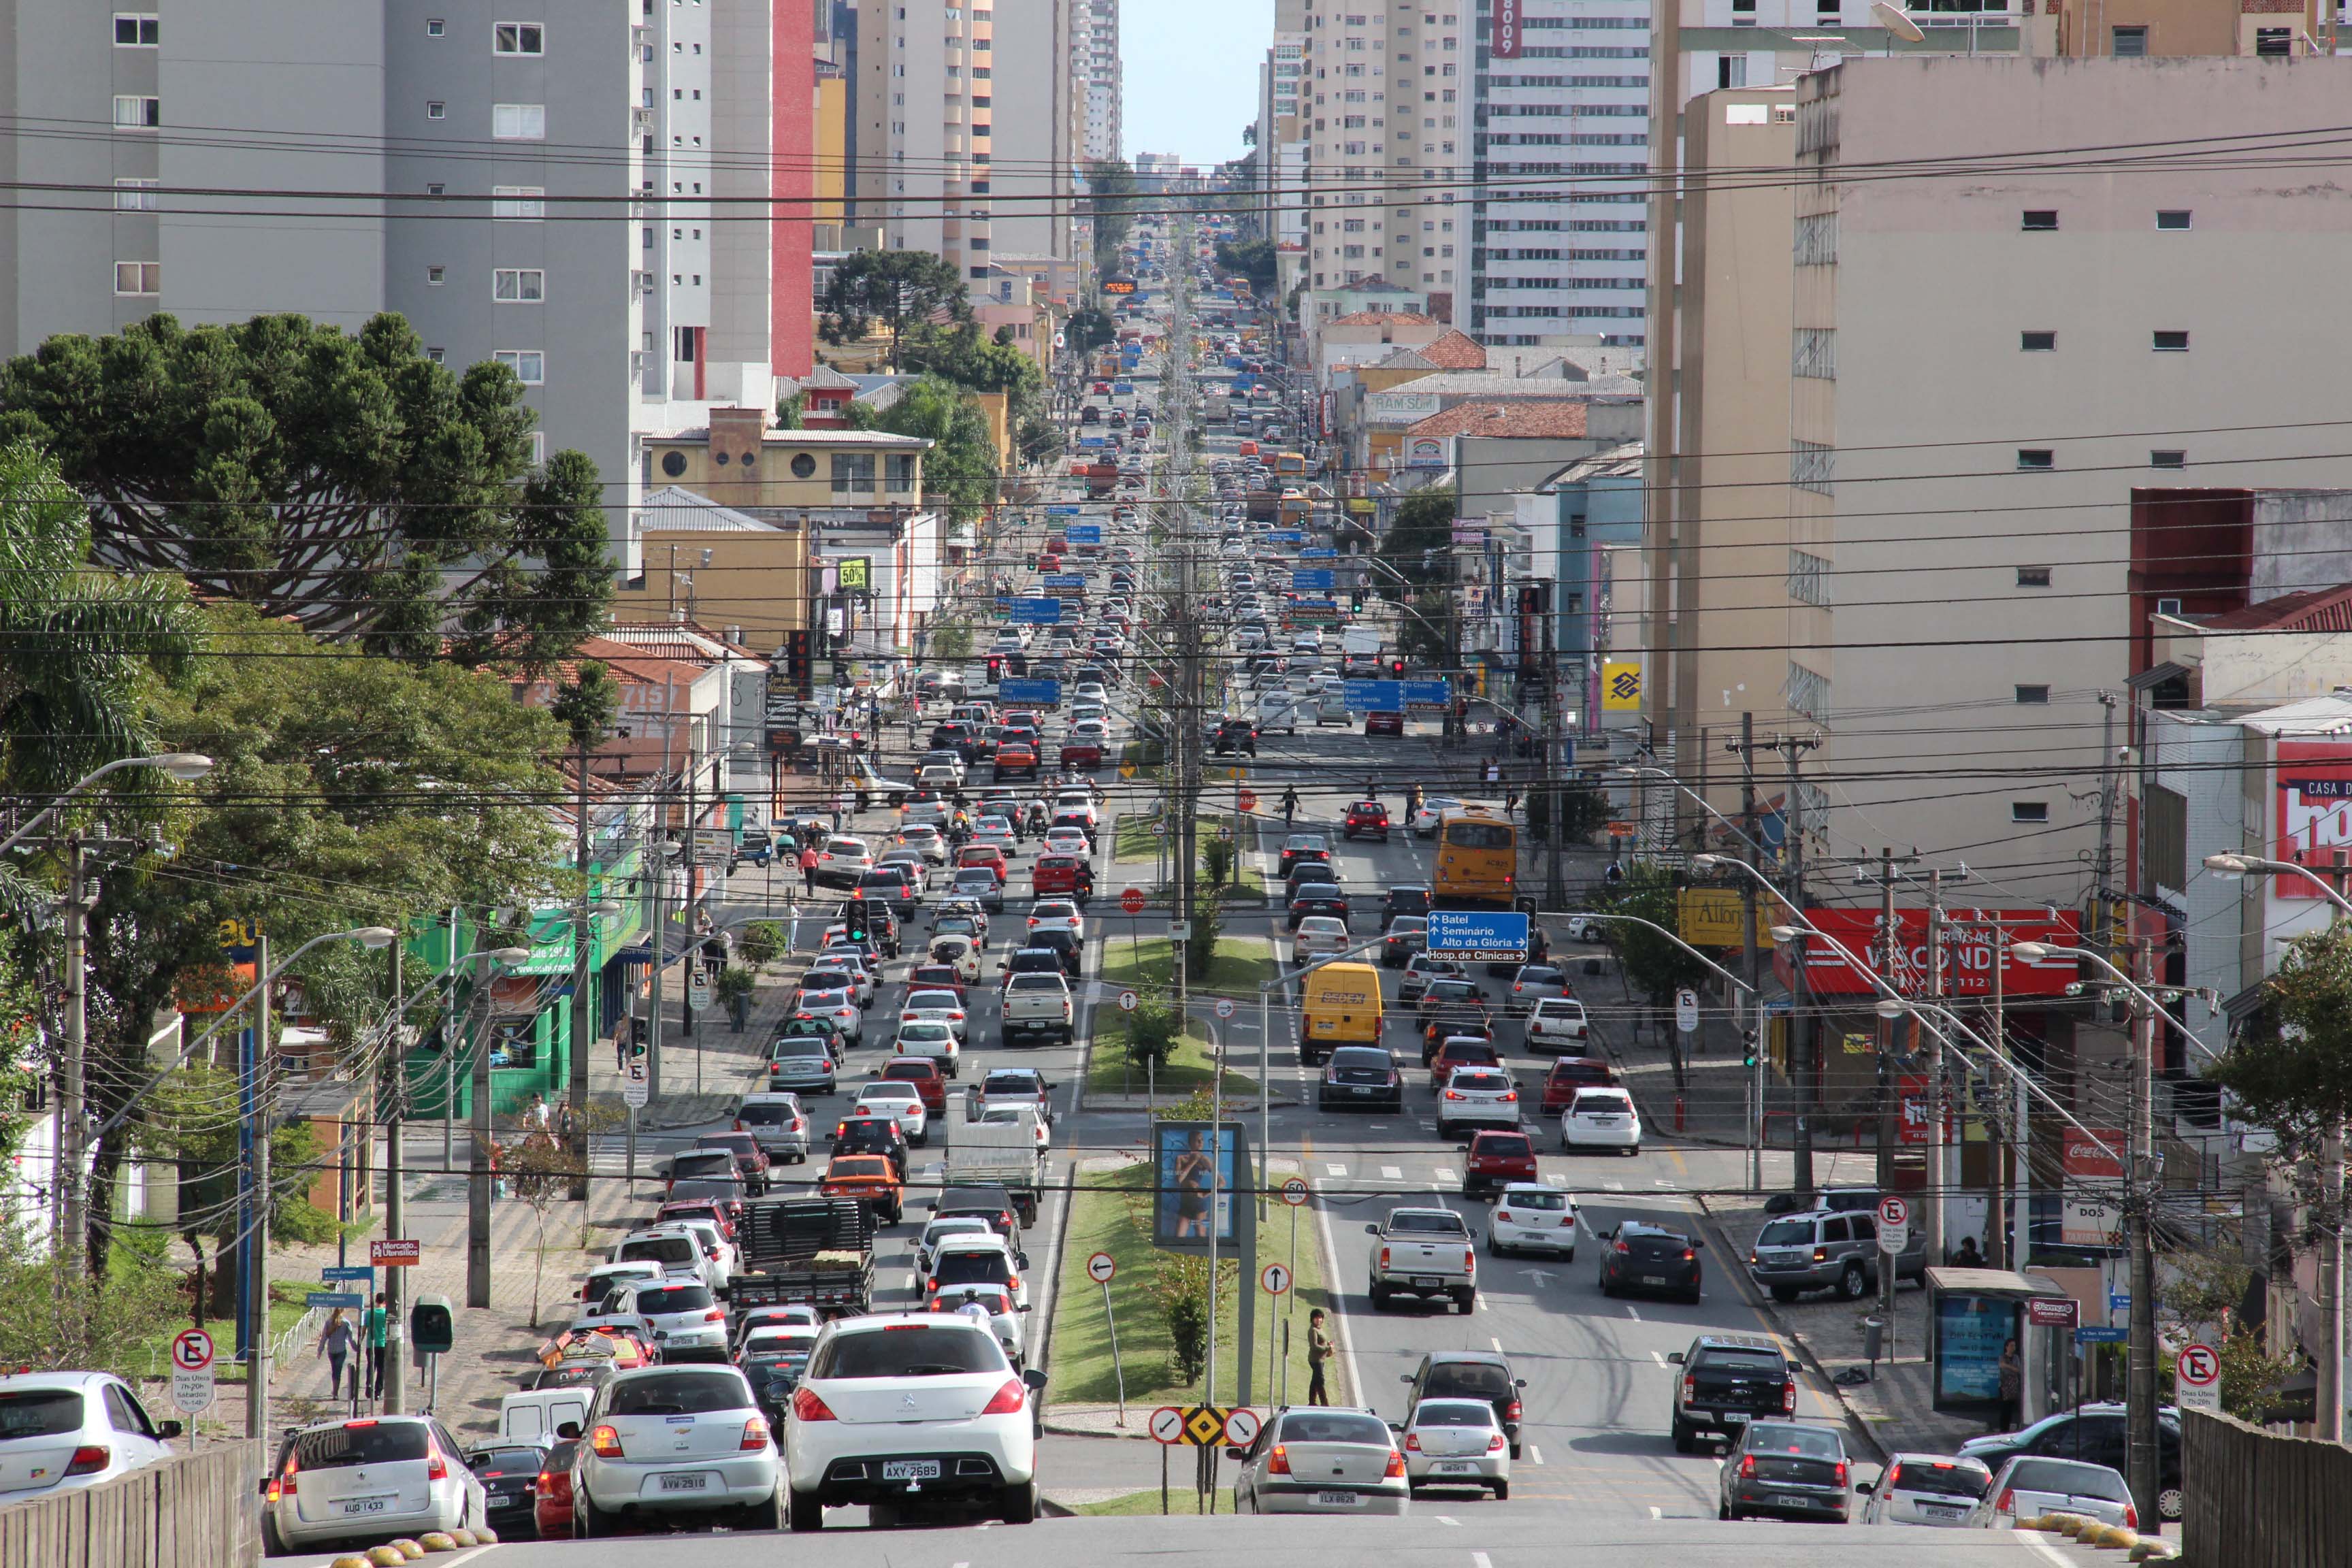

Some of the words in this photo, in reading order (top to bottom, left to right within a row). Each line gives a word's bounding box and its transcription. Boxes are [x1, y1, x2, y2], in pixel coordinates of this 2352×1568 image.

[843, 568, 863, 583] 50%
[2309, 782, 2337, 795] CASA
[1122, 897, 1144, 906] PARE
[1441, 915, 1469, 924] Batel
[1441, 926, 1494, 936] Seminário
[1441, 937, 1463, 947] Alto
[1465, 937, 1478, 947] da
[1481, 937, 1512, 947] Glória
[1428, 950, 1457, 961] Hosp.
[1458, 950, 1471, 960] de
[1474, 950, 1515, 960] Clínicas
[1864, 945, 2011, 970] VSCONDE
[1288, 1183, 1303, 1192] 50
[2080, 1208, 2105, 1218] DOS
[382, 1241, 414, 1250] Mercado
